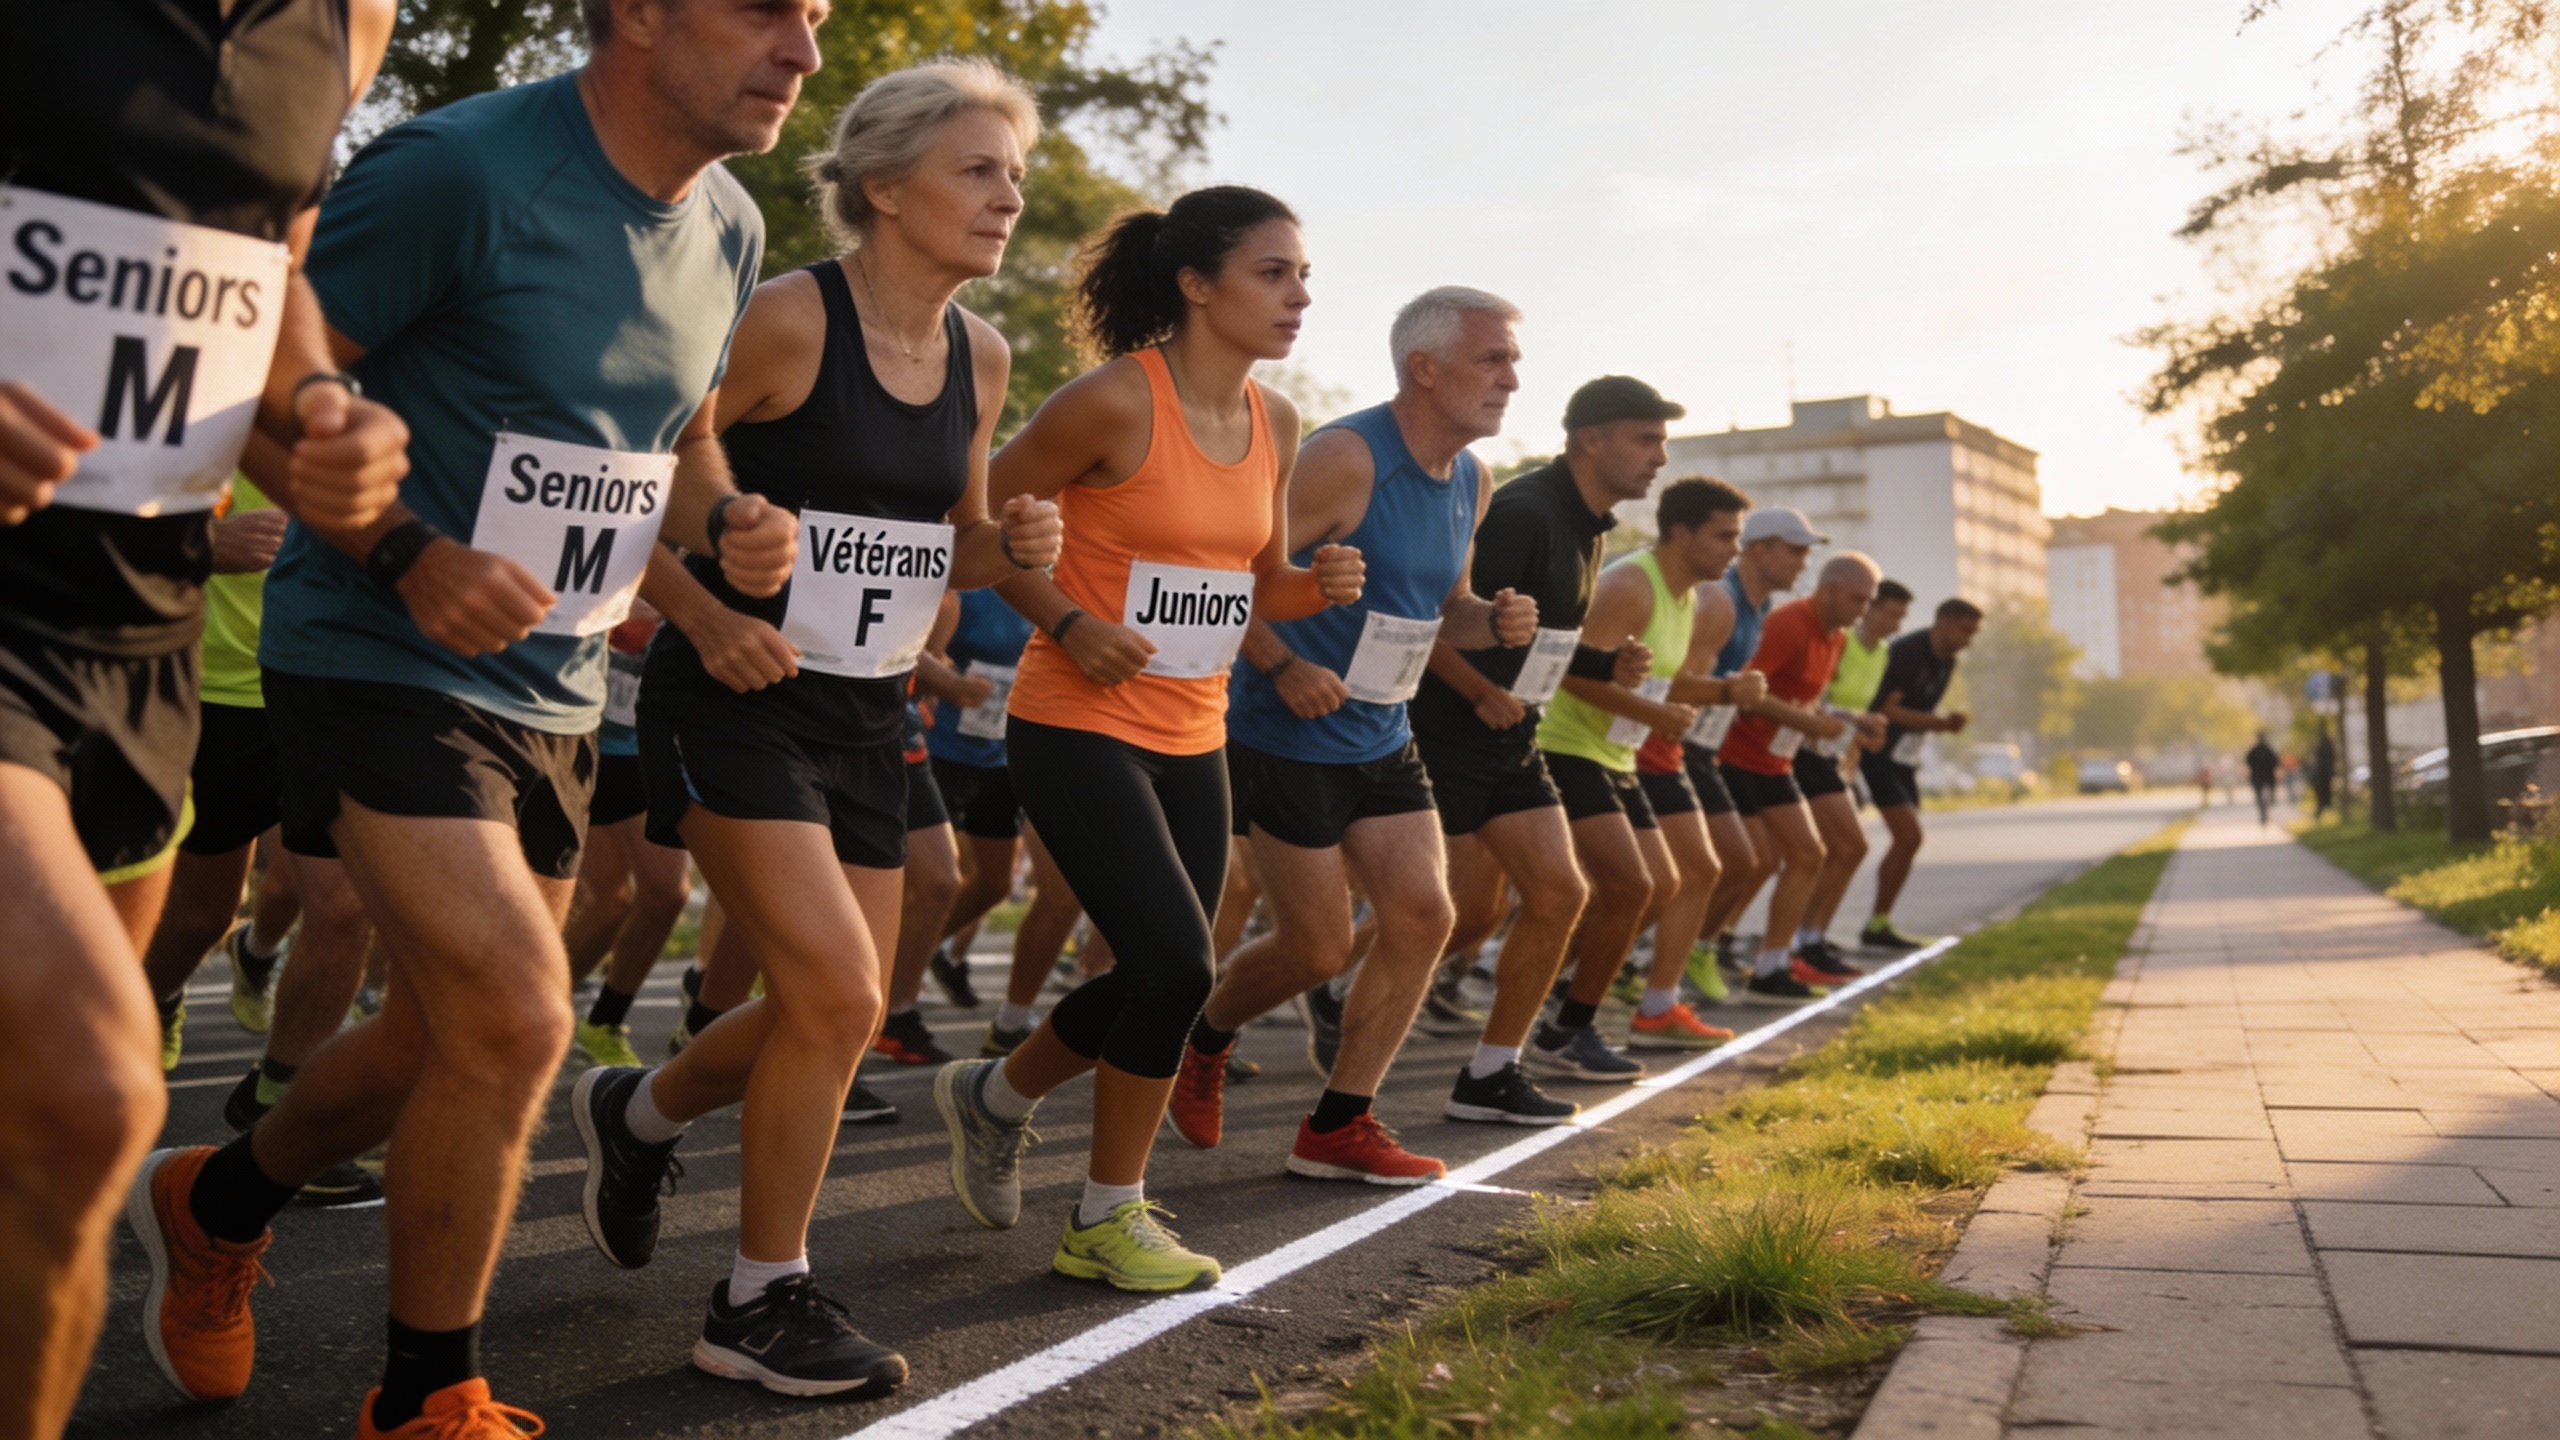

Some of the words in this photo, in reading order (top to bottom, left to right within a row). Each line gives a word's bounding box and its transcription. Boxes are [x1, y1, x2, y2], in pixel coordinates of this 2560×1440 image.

[7, 220, 260, 329] Seniors
[99, 335, 200, 447] M
[504, 453, 658, 515] Seniors
[554, 525, 617, 594] M
[809, 525, 947, 578] Vétérans
[854, 588, 892, 647] F
[1136, 577, 1249, 626] Juniors
